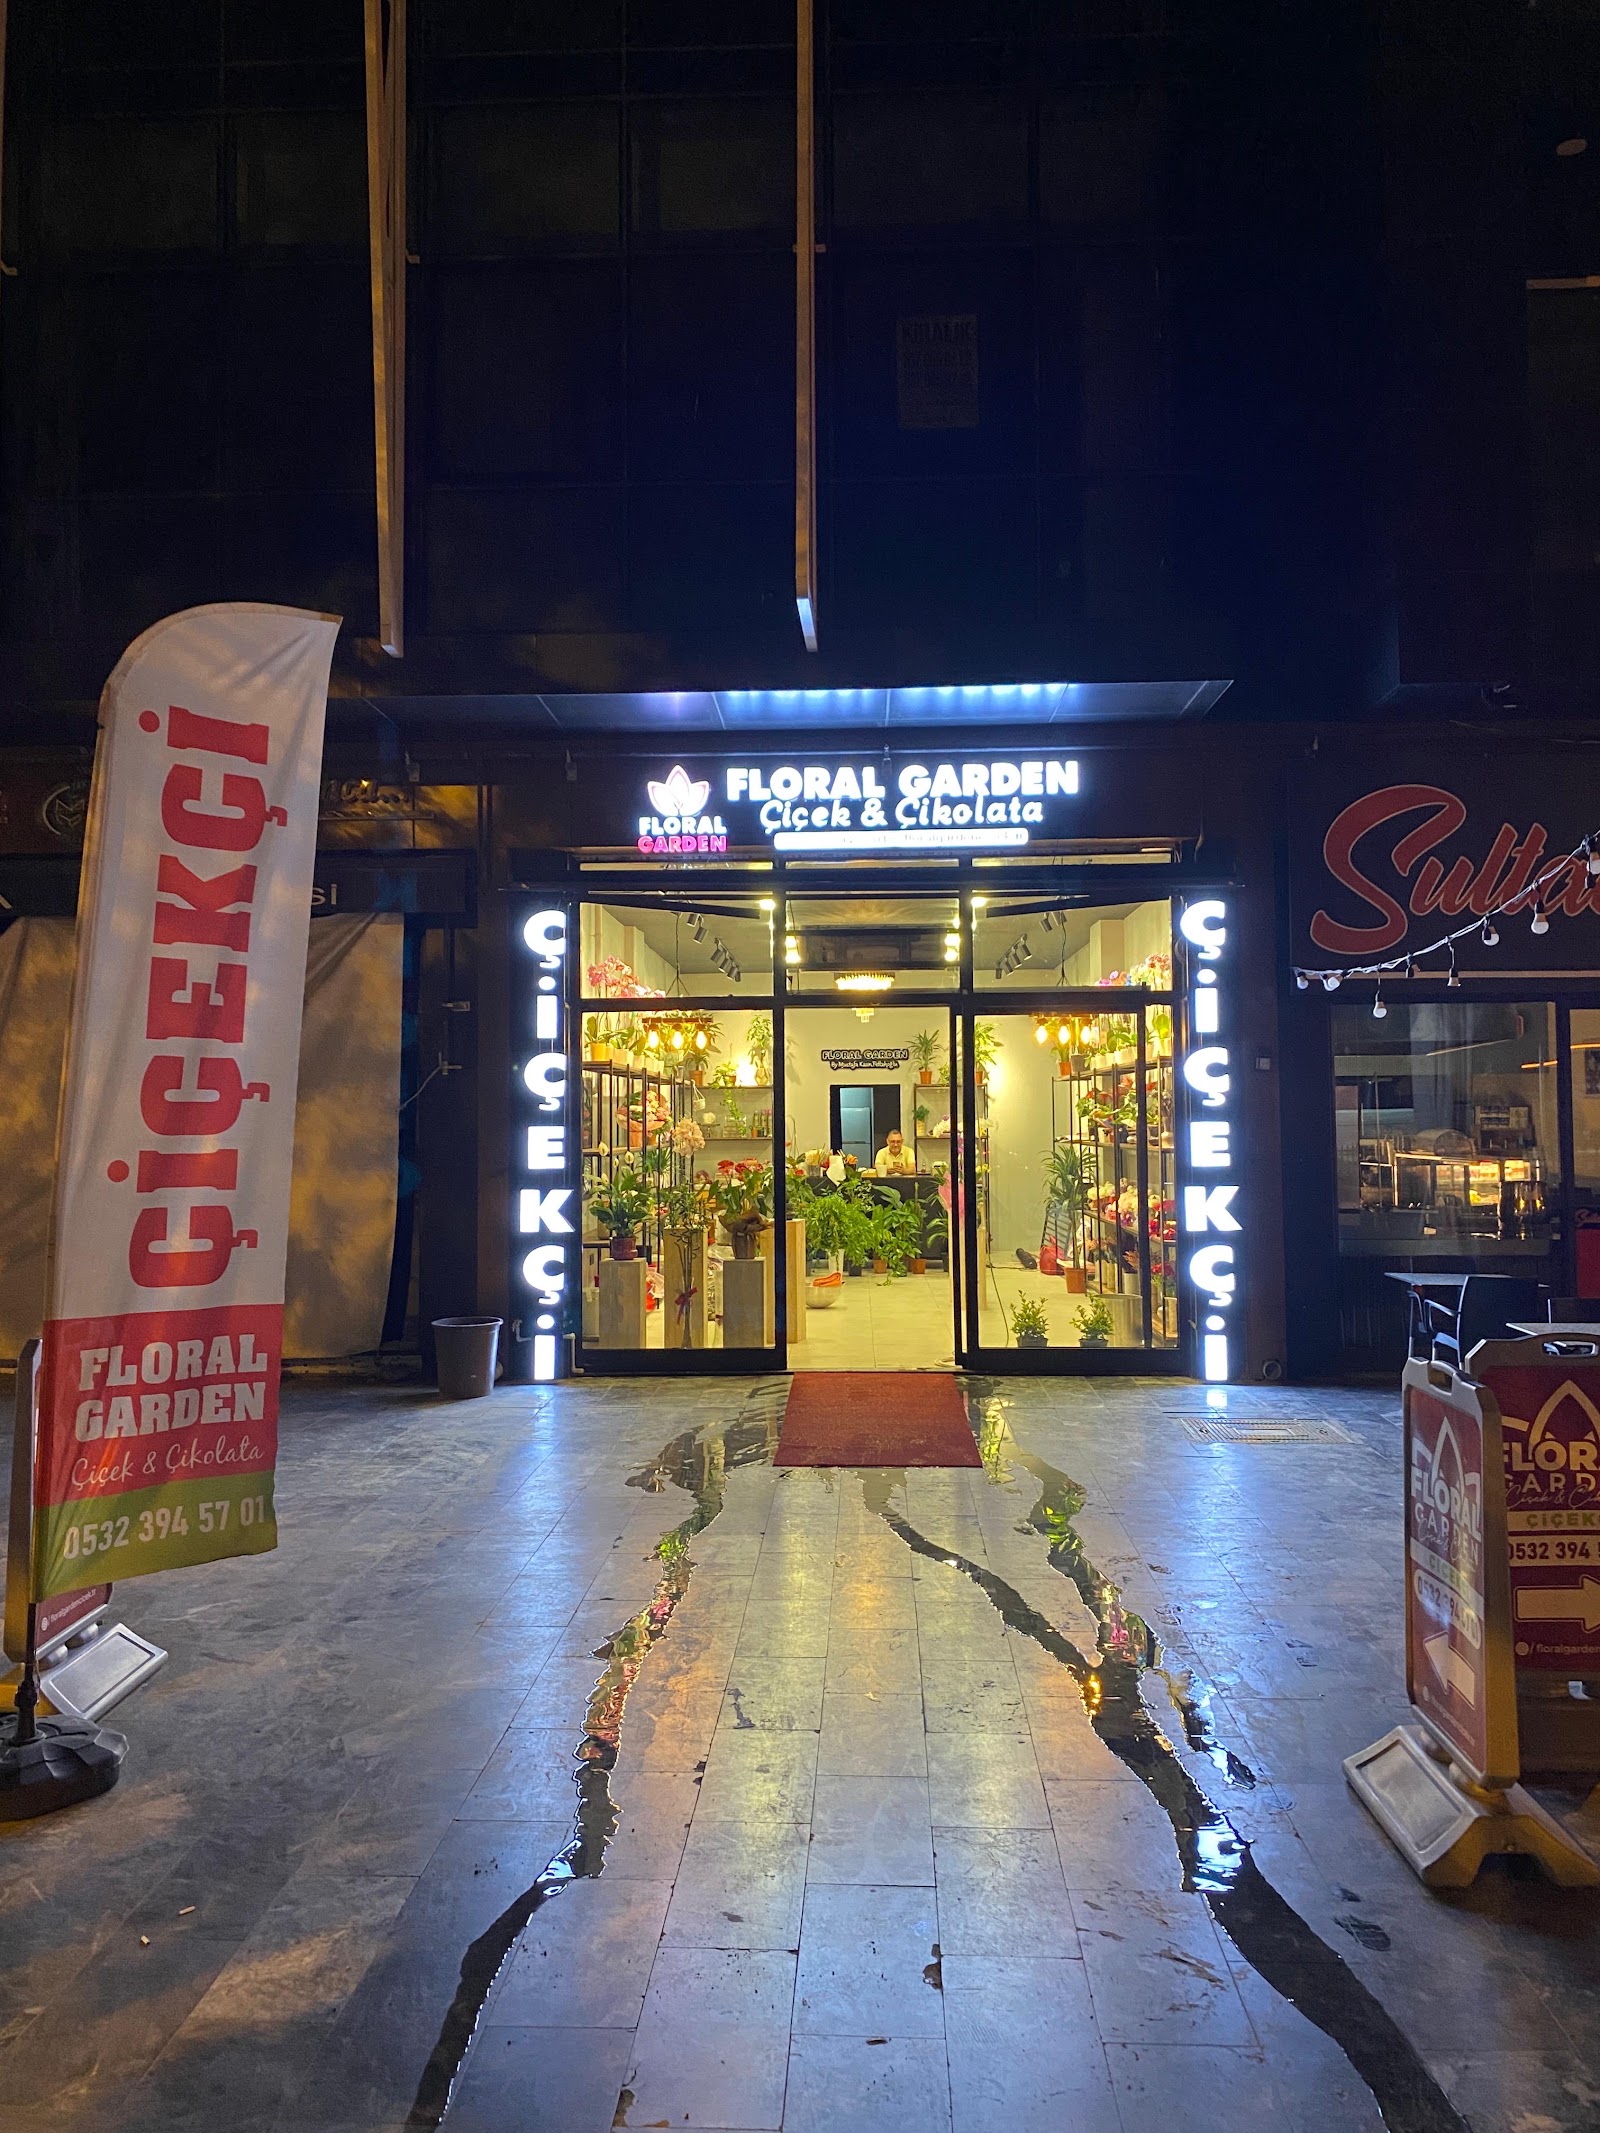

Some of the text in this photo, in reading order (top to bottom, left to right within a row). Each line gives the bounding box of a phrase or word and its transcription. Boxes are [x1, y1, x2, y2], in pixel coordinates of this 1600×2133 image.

[726, 760, 1079, 801] FLORAL GARDEN
[637, 815, 727, 835] FLORAL
[760, 796, 1044, 834] Çiçek & Çikolata
[637, 835, 727, 854] GARDEN
[1310, 784, 1600, 955] Sulta
[822, 1049, 908, 1060] FLORAL GARDEN
[79, 1334, 268, 1391] FLORAL
[75, 1382, 266, 1442] GARDEN
[72, 1435, 264, 1490] Çiçek & Çikolata
[1503, 1440, 1600, 1471] LOR
[1411, 1465, 1482, 1543] FLORAL
[1526, 1512, 1600, 1529] ÇİÇEK
[63, 1495, 266, 1559] 0532 394 57 01
[1415, 1502, 1479, 1566] GARDEN
[1550, 1541, 1590, 1559] 394
